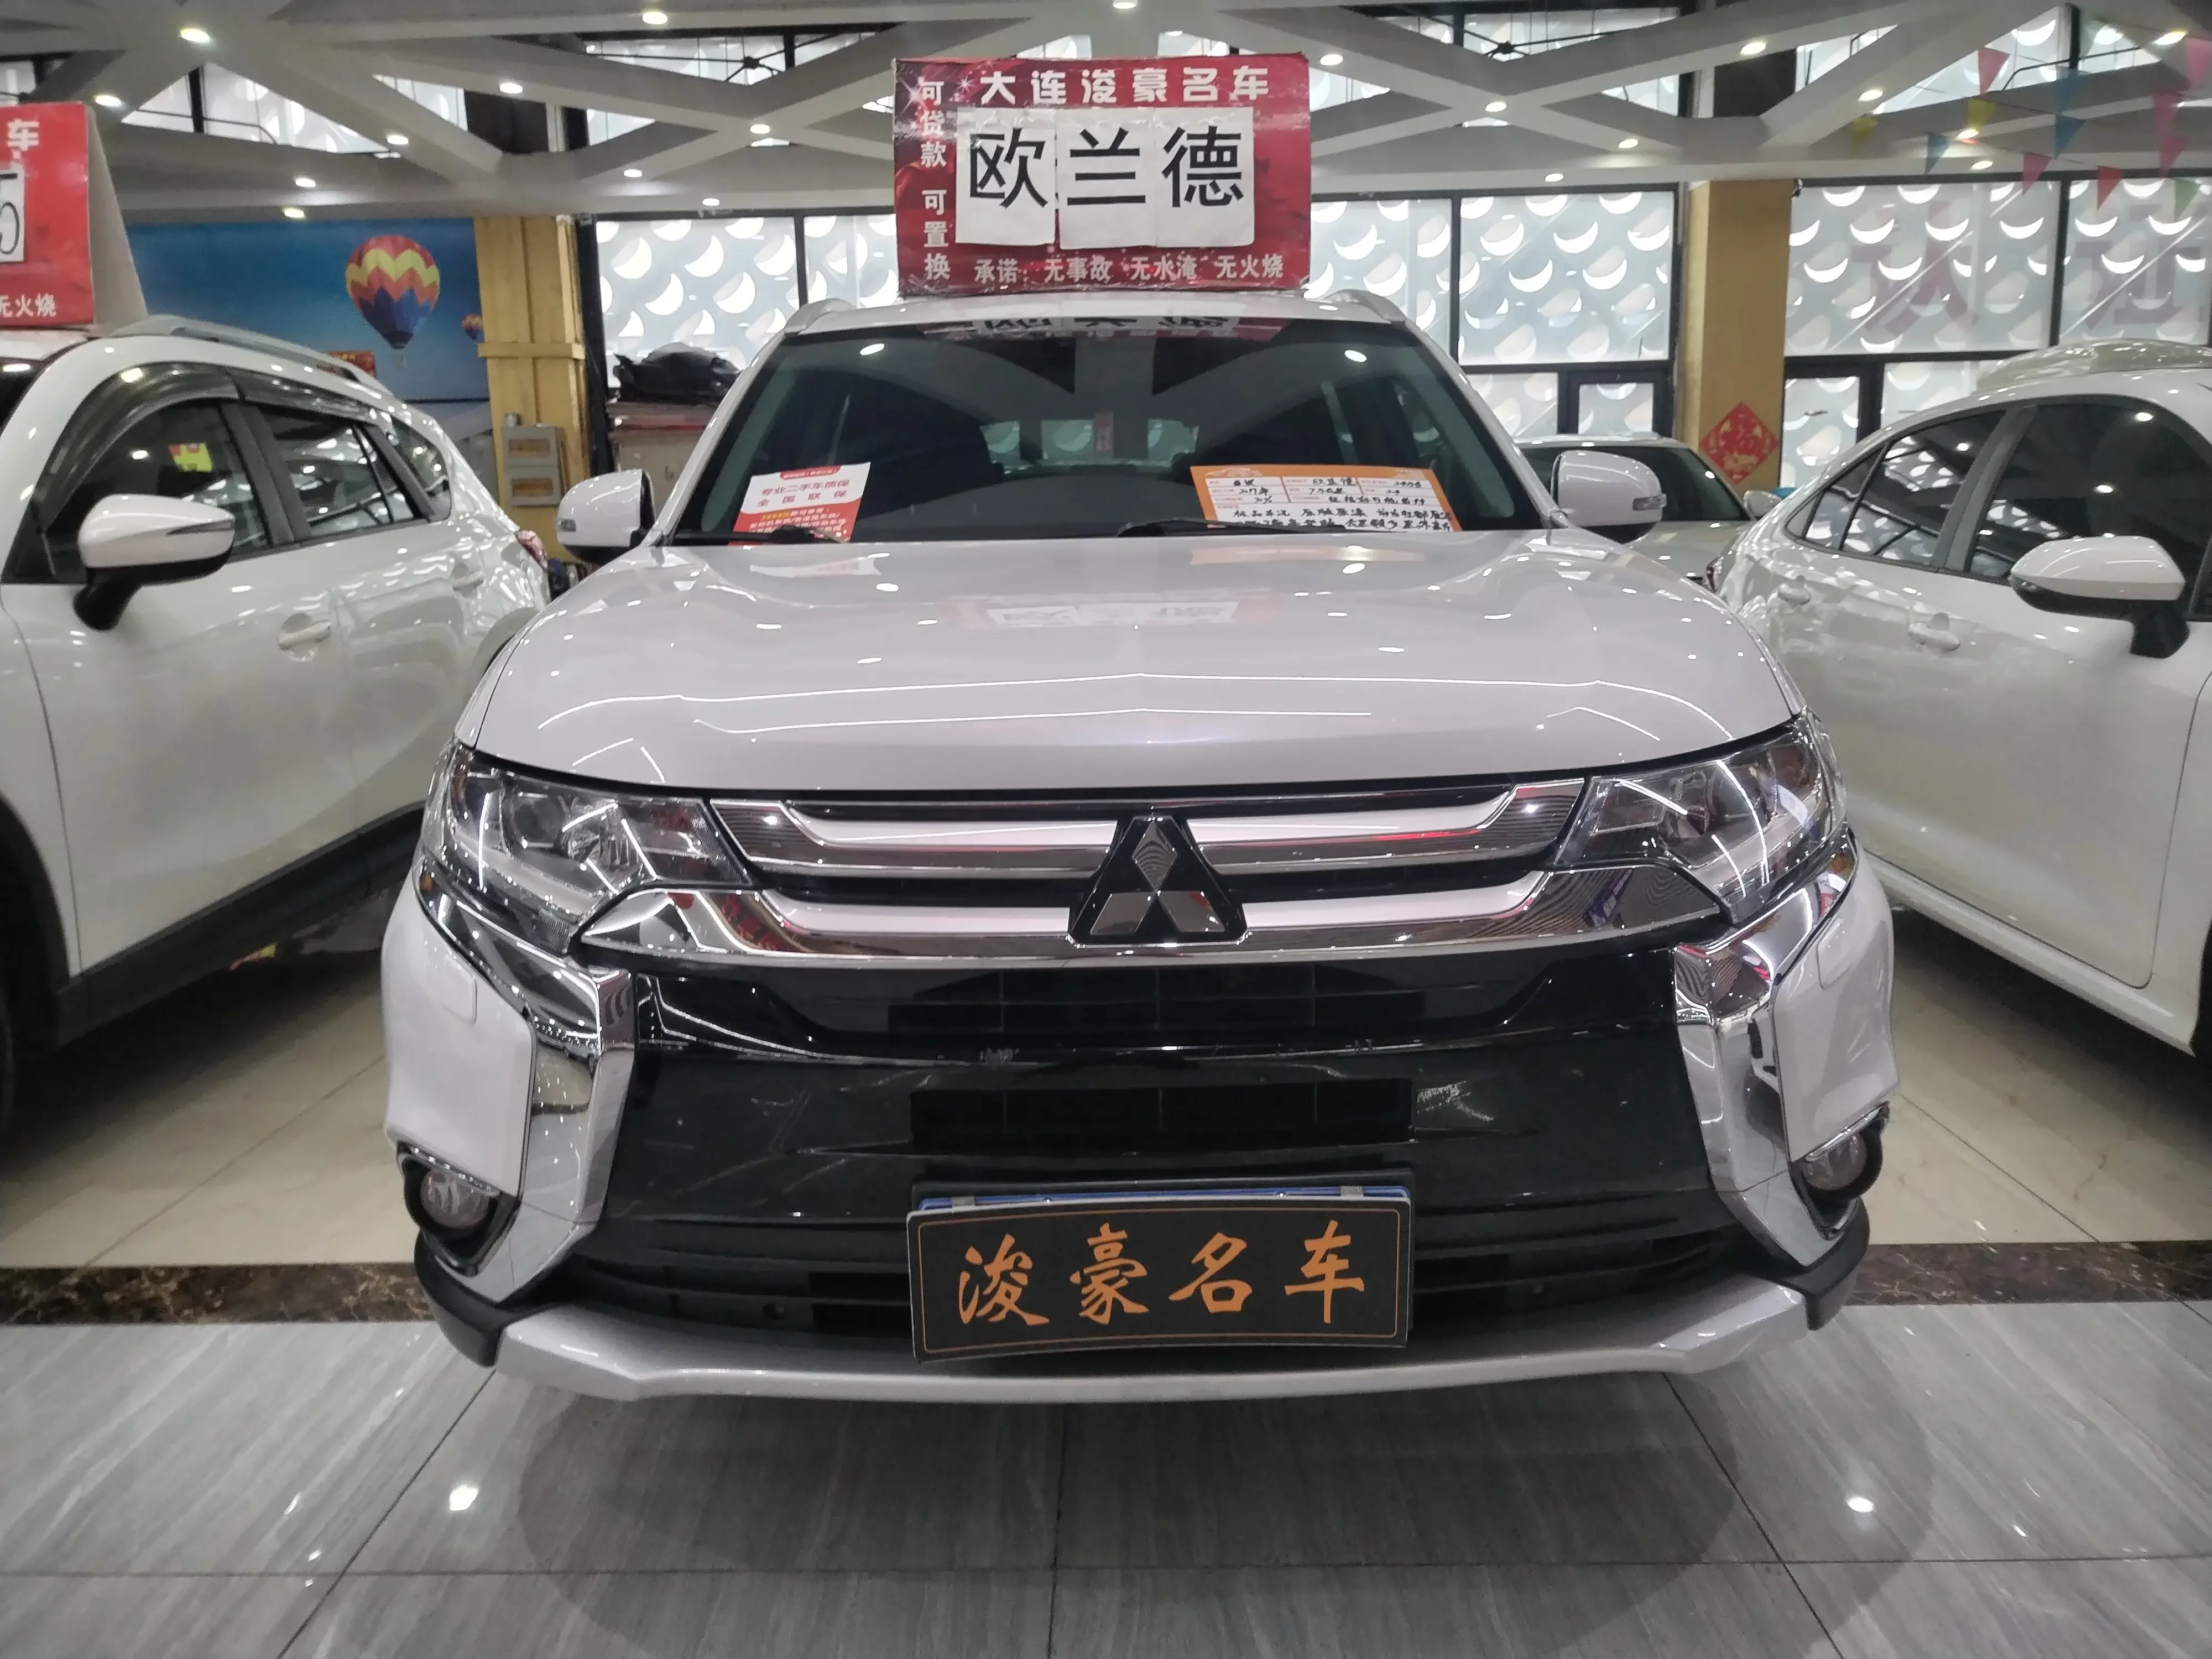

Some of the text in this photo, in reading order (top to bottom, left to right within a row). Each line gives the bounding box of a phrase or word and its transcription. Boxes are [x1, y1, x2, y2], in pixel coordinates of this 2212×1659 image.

[980, 65, 1270, 106] 大连浚豪名车
[969, 126, 1244, 208] 欧兰德
[1045, 256, 1113, 284] 无事故
[1130, 255, 1198, 281] 无水淹
[1215, 254, 1284, 279] 无火烧
[757, 490, 848, 508] 全国联保
[959, 1220, 1364, 1326] 浚豪名车
